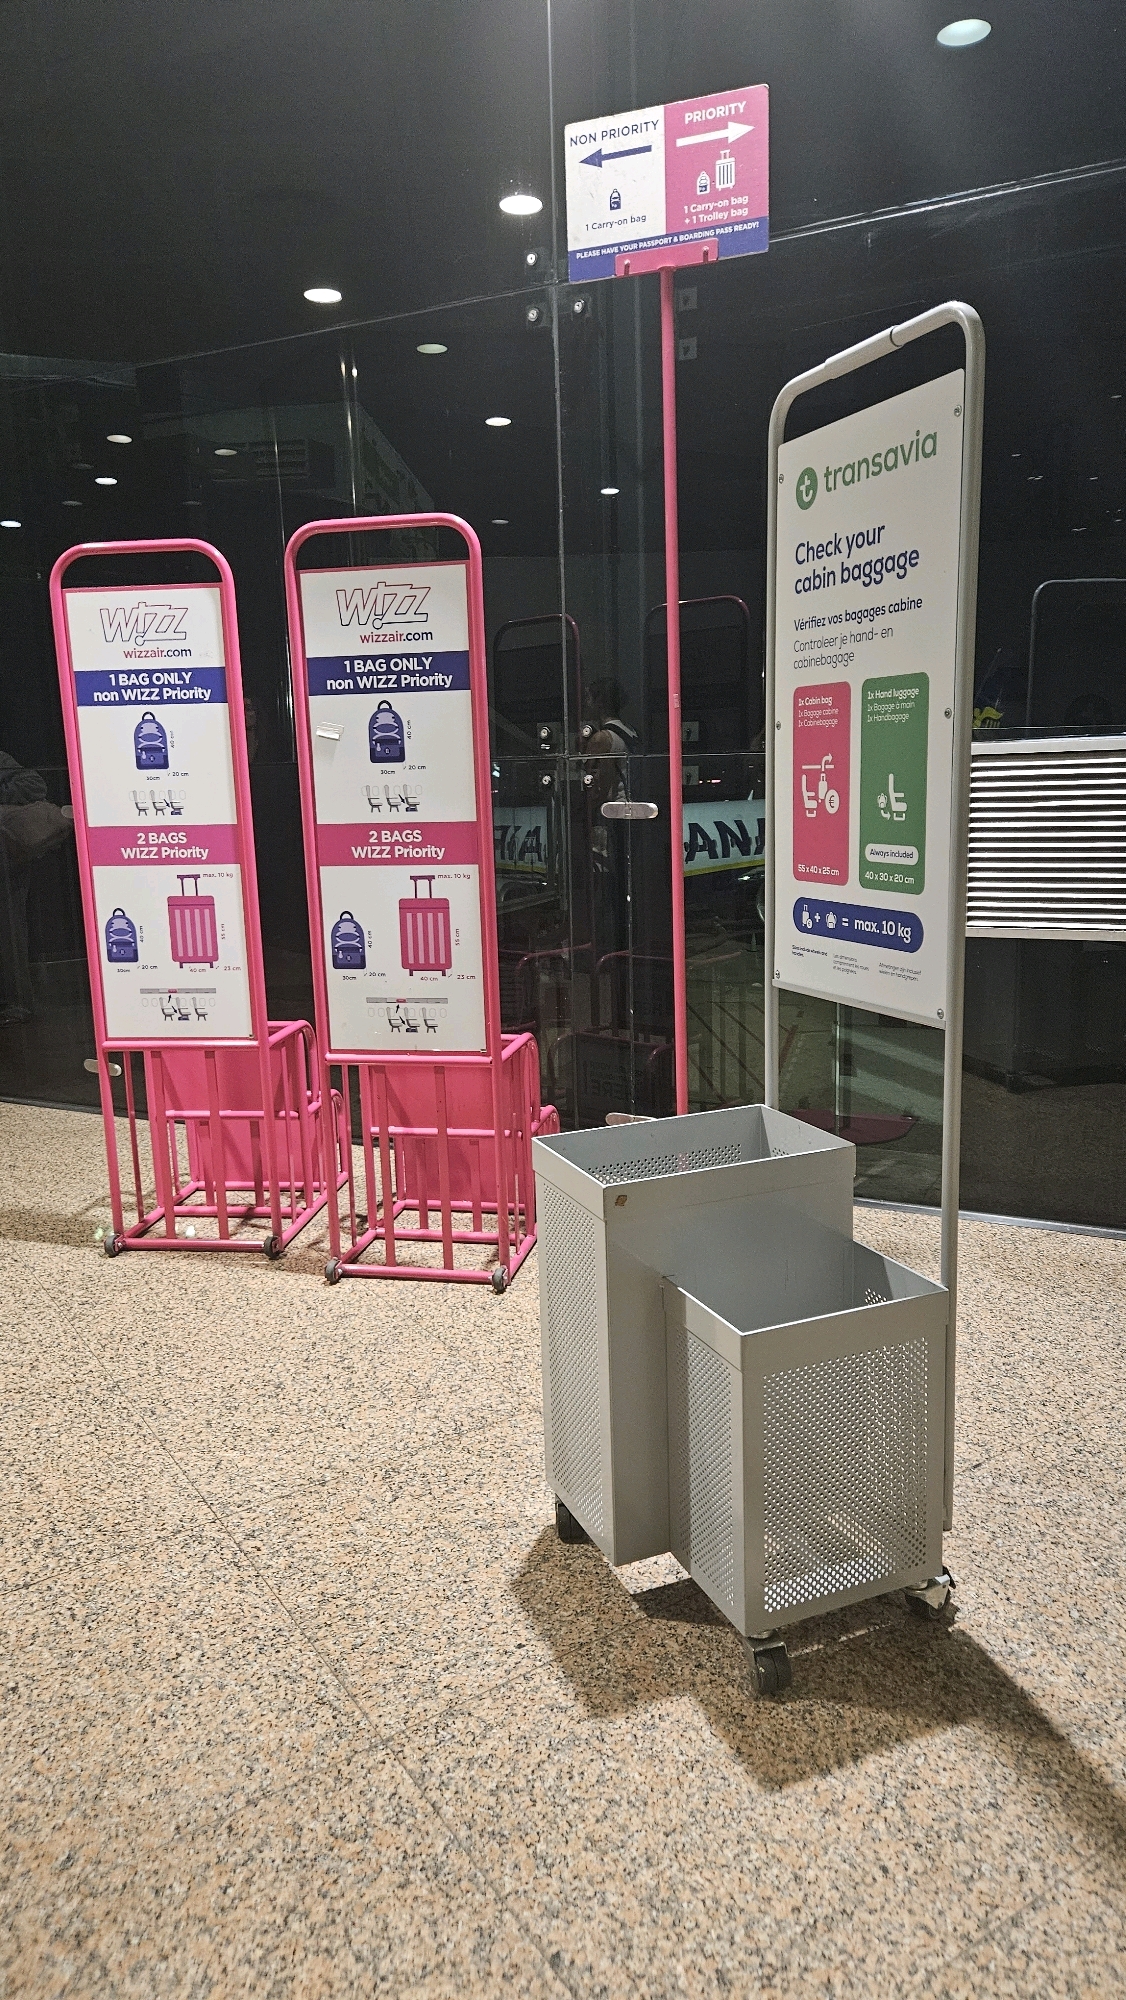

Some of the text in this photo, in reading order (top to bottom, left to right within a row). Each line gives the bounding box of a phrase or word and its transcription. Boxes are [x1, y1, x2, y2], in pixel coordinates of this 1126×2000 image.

[685, 101, 747, 125] PRIORITY
[570, 119, 659, 147] NON PRIORITY
[690, 199, 729, 212] Carry-on
[731, 196, 748, 205] bag
[591, 217, 628, 230] Carry-on
[631, 215, 647, 223] bag
[692, 216, 696, 224] 1
[699, 211, 729, 222] Trolley
[731, 208, 748, 217] bag
[576, 250, 600, 260] PLEASE
[601, 247, 619, 256] HAVE
[620, 243, 638, 253] YOUR
[639, 237, 672, 249] PASSPORT
[679, 230, 714, 241] BOARDING
[716, 226, 733, 235] PASS
[734, 222, 759, 231] READY!
[824, 430, 937, 492] transavia
[795, 525, 885, 565] Check your
[795, 549, 919, 594] cabin baggage
[794, 597, 922, 631] Vérifiez vos bagages cabine
[360, 631, 433, 643] wizzair.com
[794, 627, 893, 652] Controleer je hand- en
[123, 647, 191, 658] wizzair.com
[344, 657, 432, 673] 1 BAG ONLY
[794, 651, 855, 669] cabinebagage
[109, 672, 192, 685] 1 BAG ONLY
[327, 673, 452, 690] non WIZZ Priority
[94, 687, 211, 701] non WIZZ Priority
[868, 688, 919, 699] 1x Hand luggage
[805, 697, 820, 705] Cabin
[821, 696, 832, 706] bag
[874, 703, 895, 713] Bagage
[804, 709, 821, 718] Bagage
[874, 713, 909, 723] Handbagage
[804, 719, 838, 727] Cabinebagage
[137, 832, 187, 844] 2 BAGS
[369, 829, 422, 843] 2 BAGS
[121, 846, 208, 860] WIZZ Priority
[351, 845, 445, 860] WIZZ Priority
[870, 849, 913, 858] Always included
[798, 864, 805, 872] 55
[865, 871, 873, 879] 40
[880, 873, 888, 881] 30
[894, 874, 903, 883] 20
[455, 929, 460, 937] cm
[854, 919, 880, 933] max.
[882, 920, 895, 935] 10
[898, 923, 911, 943] kg
